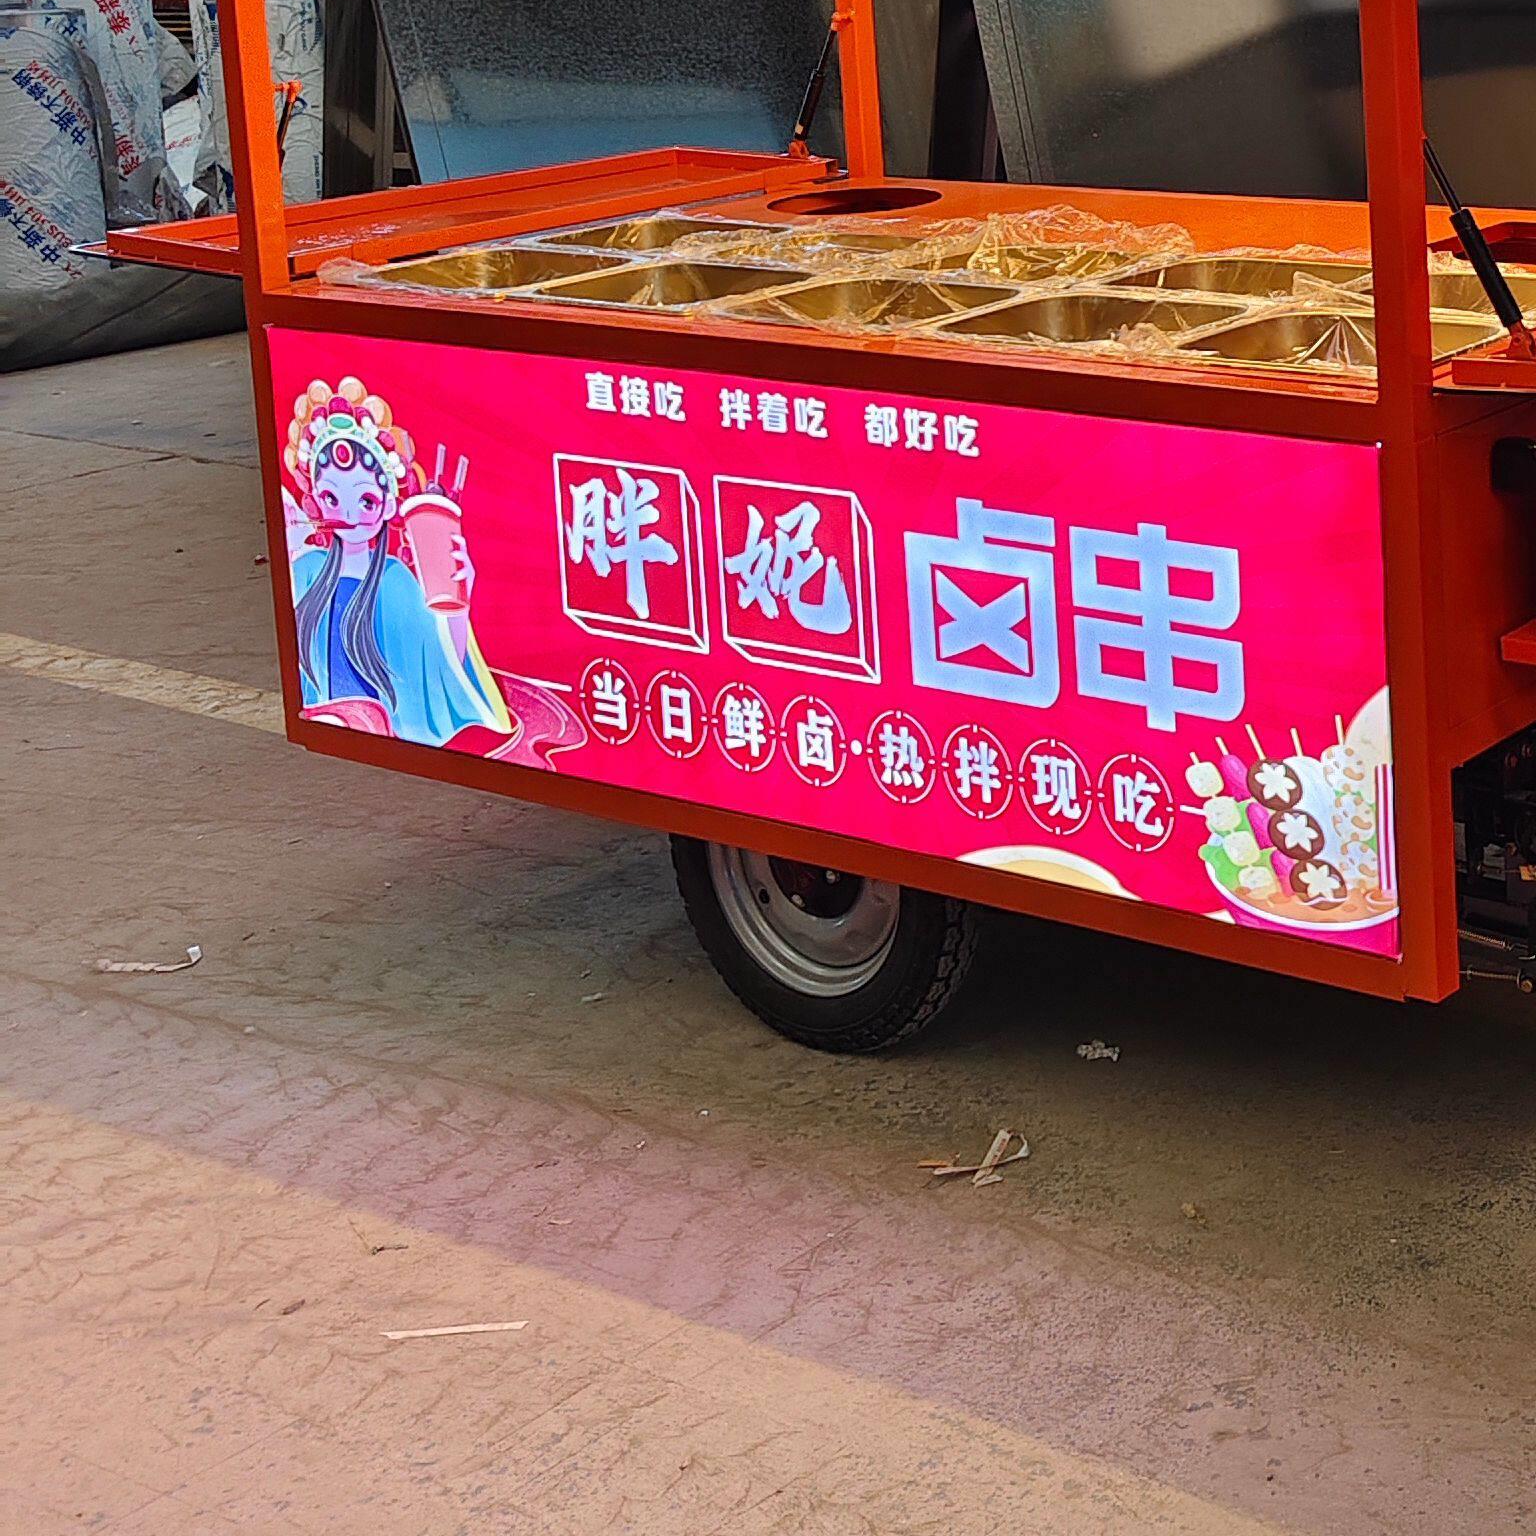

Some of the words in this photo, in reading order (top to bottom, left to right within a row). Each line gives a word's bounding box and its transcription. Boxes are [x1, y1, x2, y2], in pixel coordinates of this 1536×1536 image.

[585, 371, 686, 422] 直接吃
[719, 388, 828, 438] 拌着吃
[864, 403, 979, 457] 都好吃
